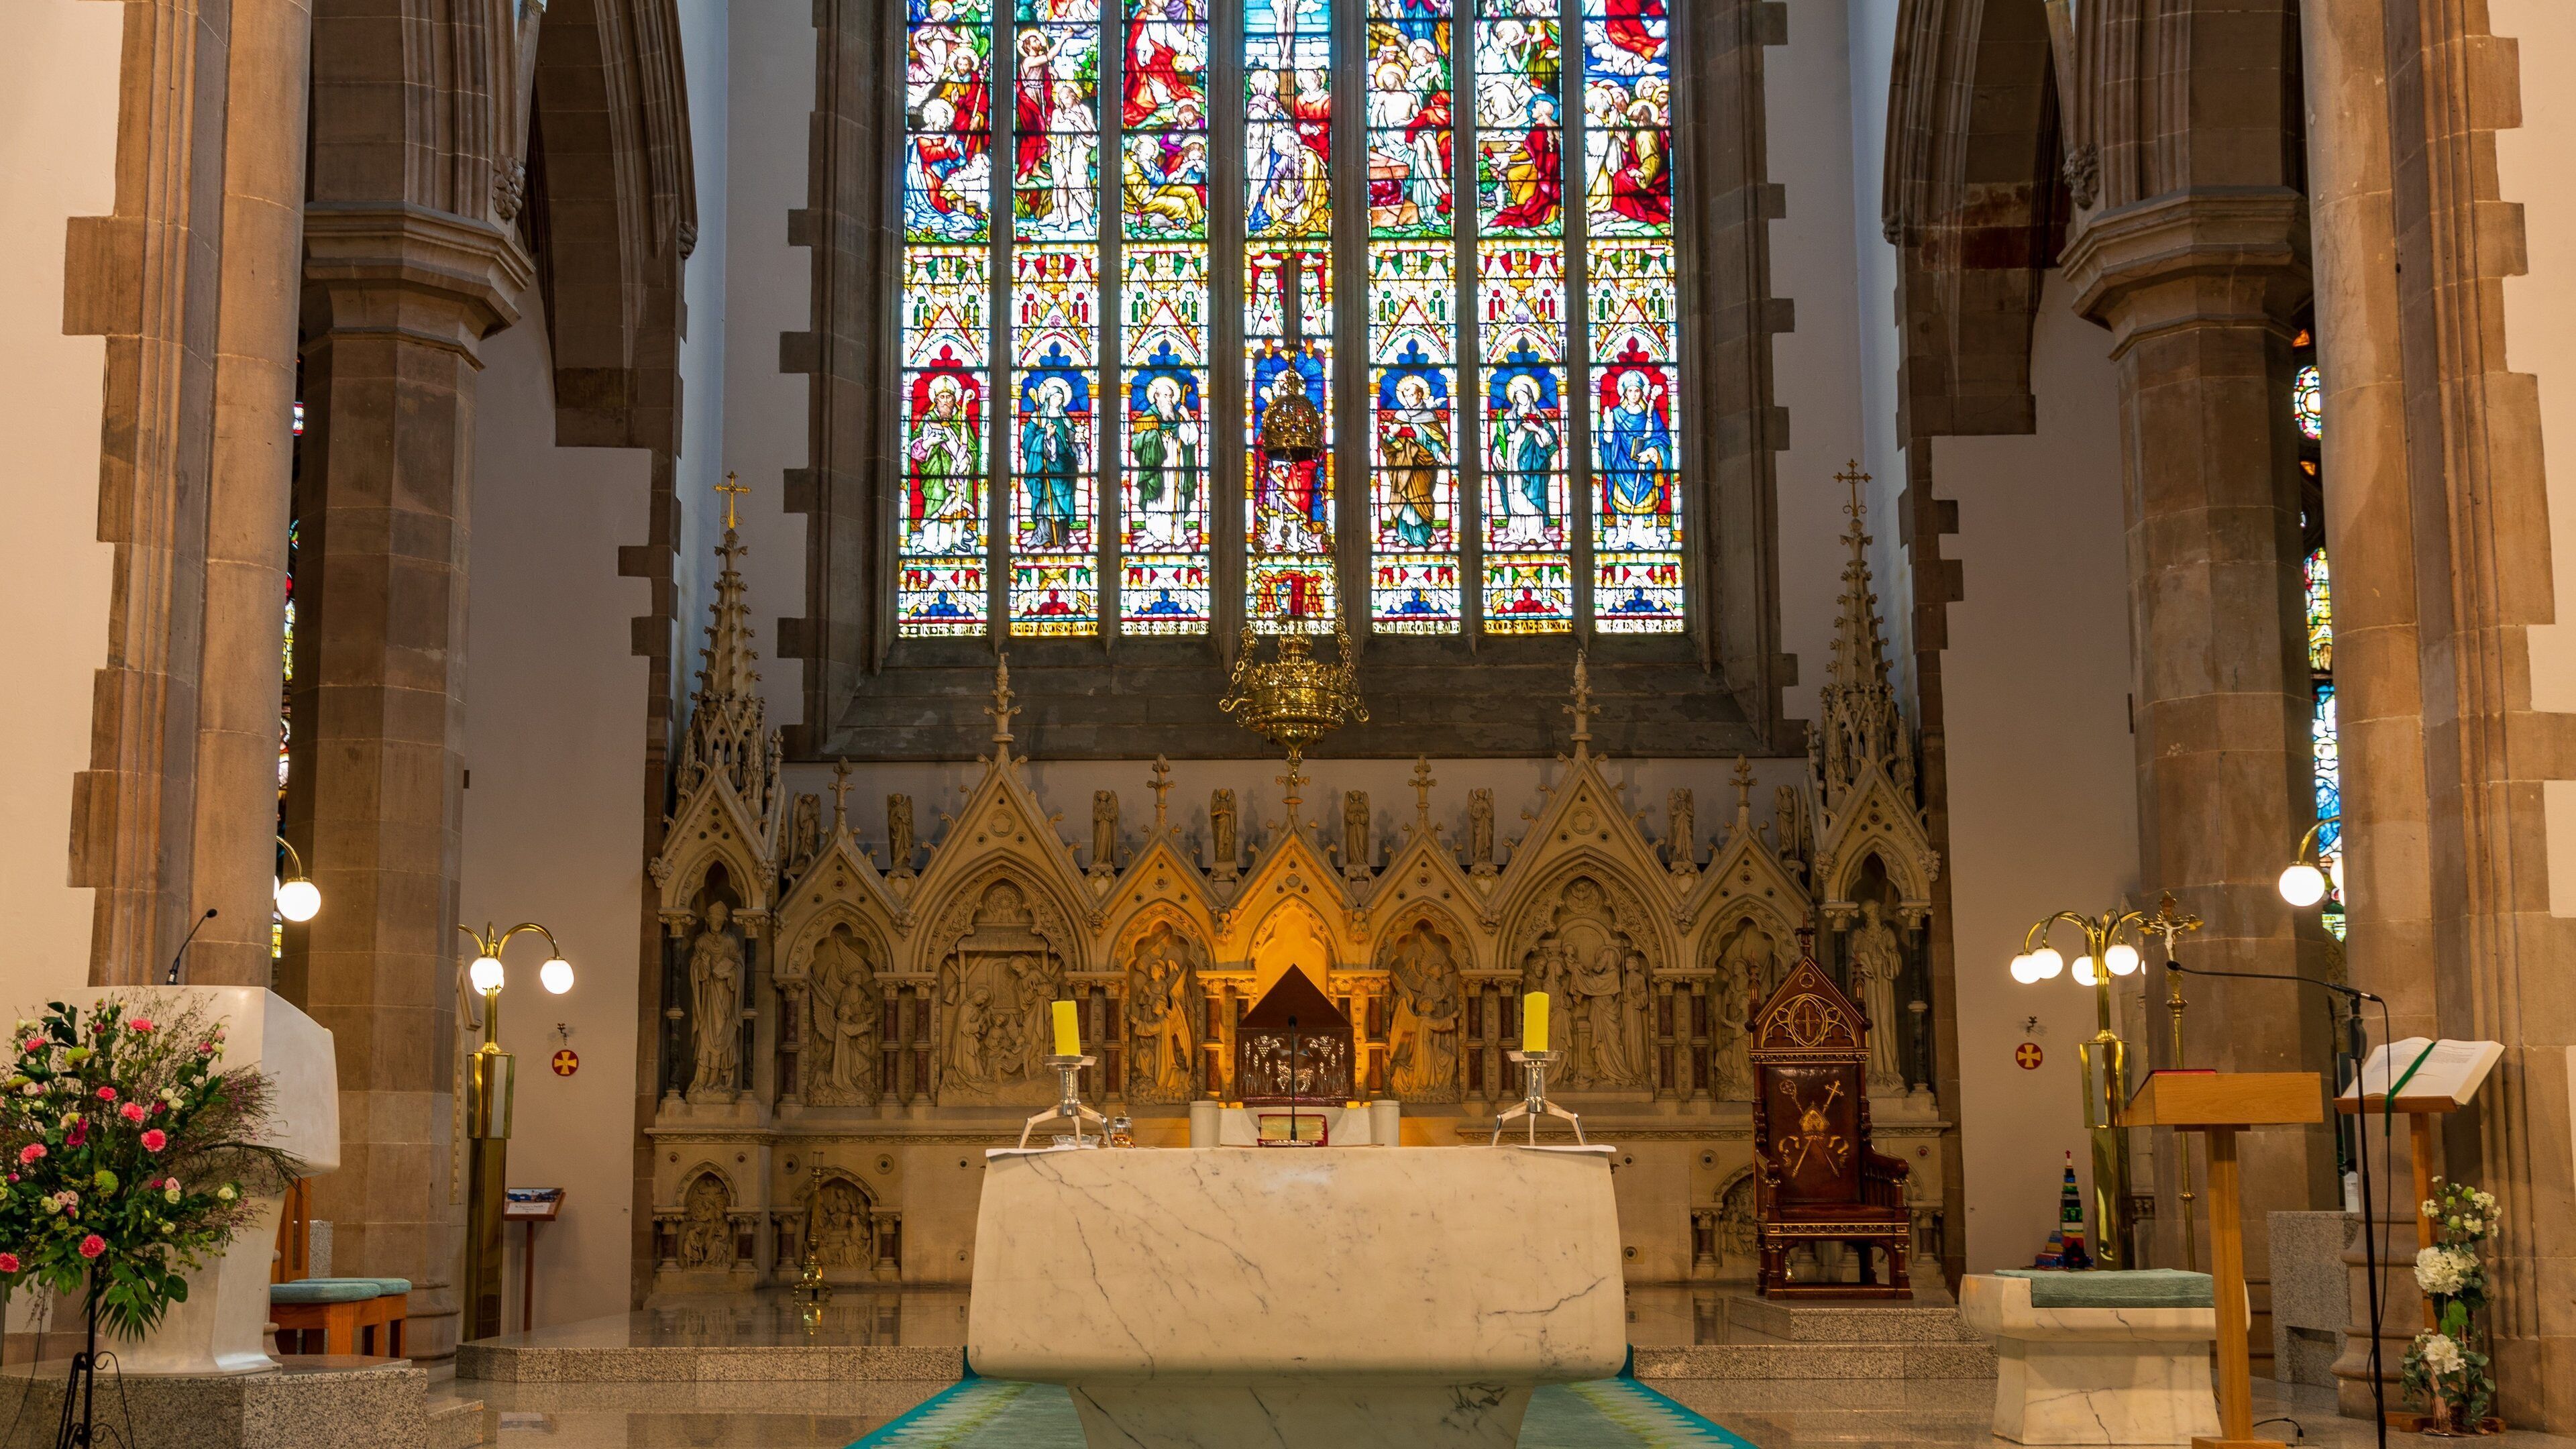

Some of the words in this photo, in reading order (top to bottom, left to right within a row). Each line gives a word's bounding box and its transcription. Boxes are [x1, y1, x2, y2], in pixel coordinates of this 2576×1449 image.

[920, 626, 930, 635] IN
[937, 626, 983, 635] MEMORIAM
[1073, 624, 1097, 633] KELLY
[1538, 622, 1568, 631] EREXIT
